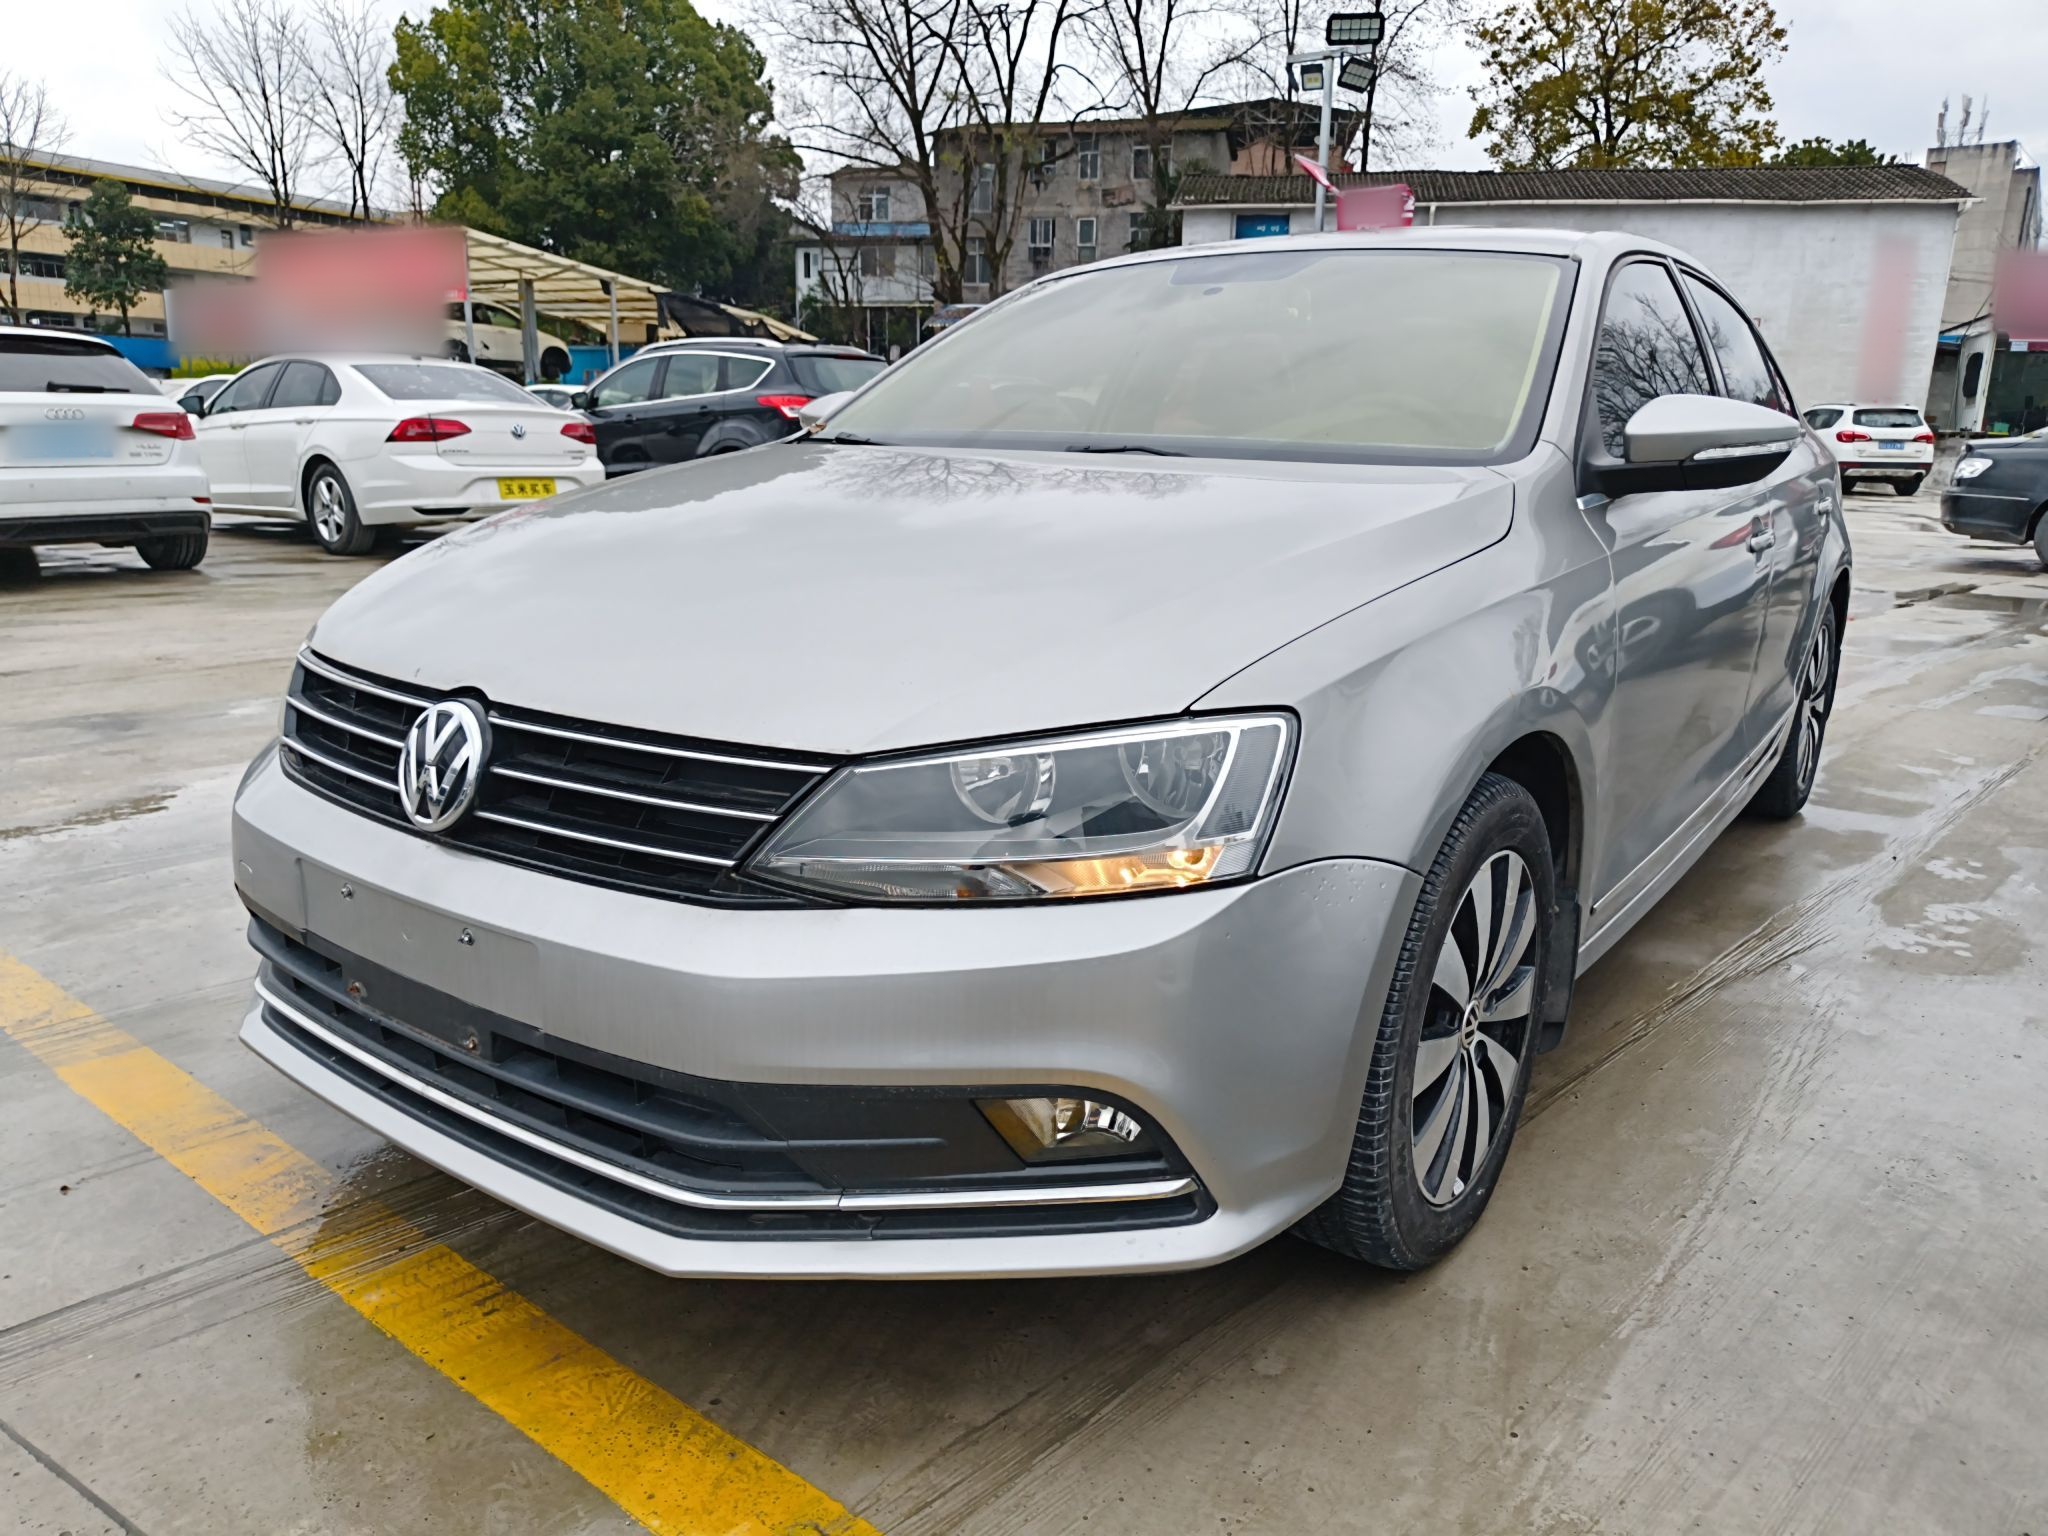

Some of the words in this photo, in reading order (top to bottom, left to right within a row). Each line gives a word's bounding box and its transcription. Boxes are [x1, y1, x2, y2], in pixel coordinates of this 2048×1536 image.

[503, 483, 553, 496] 玉米买车
[400, 701, 482, 830] VW
